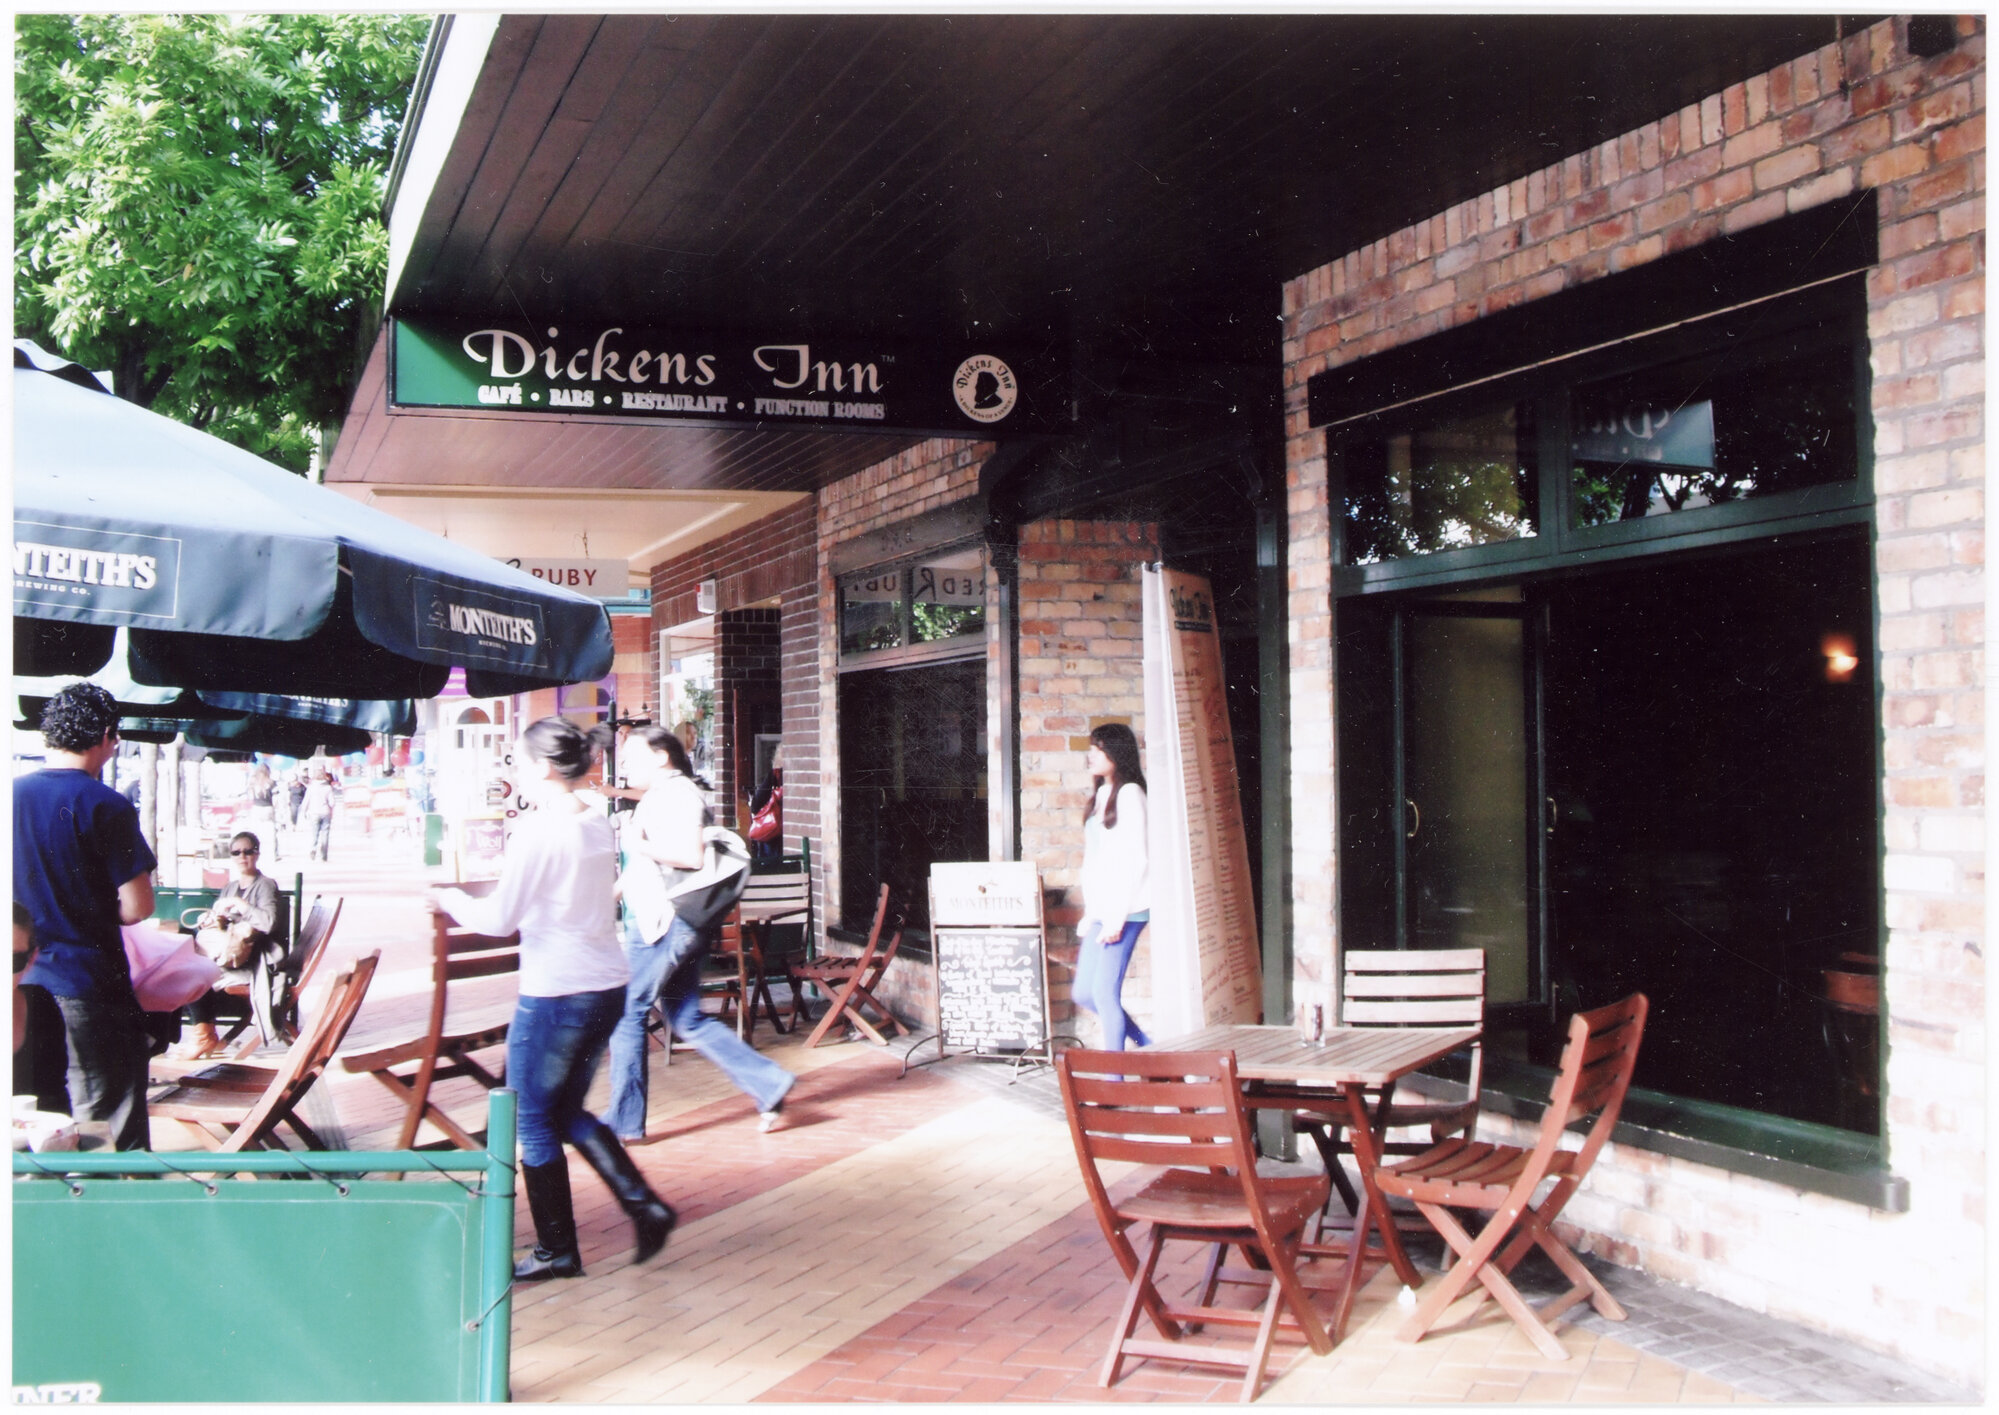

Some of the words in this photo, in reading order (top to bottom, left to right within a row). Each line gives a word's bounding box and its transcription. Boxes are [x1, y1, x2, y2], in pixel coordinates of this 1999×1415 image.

[462, 326, 716, 386] Dickens
[752, 344, 884, 394] Inn
[956, 360, 992, 389] Dickens
[477, 382, 523, 405] CAFÉ
[549, 388, 595, 408] BARS
[621, 391, 729, 413] RESTAURANT
[754, 398, 830, 417] FUNCTION
[833, 402, 886, 420] ROOMS
[70, 586, 91, 596] CO.
[448, 603, 538, 646] MONTEITH'S
